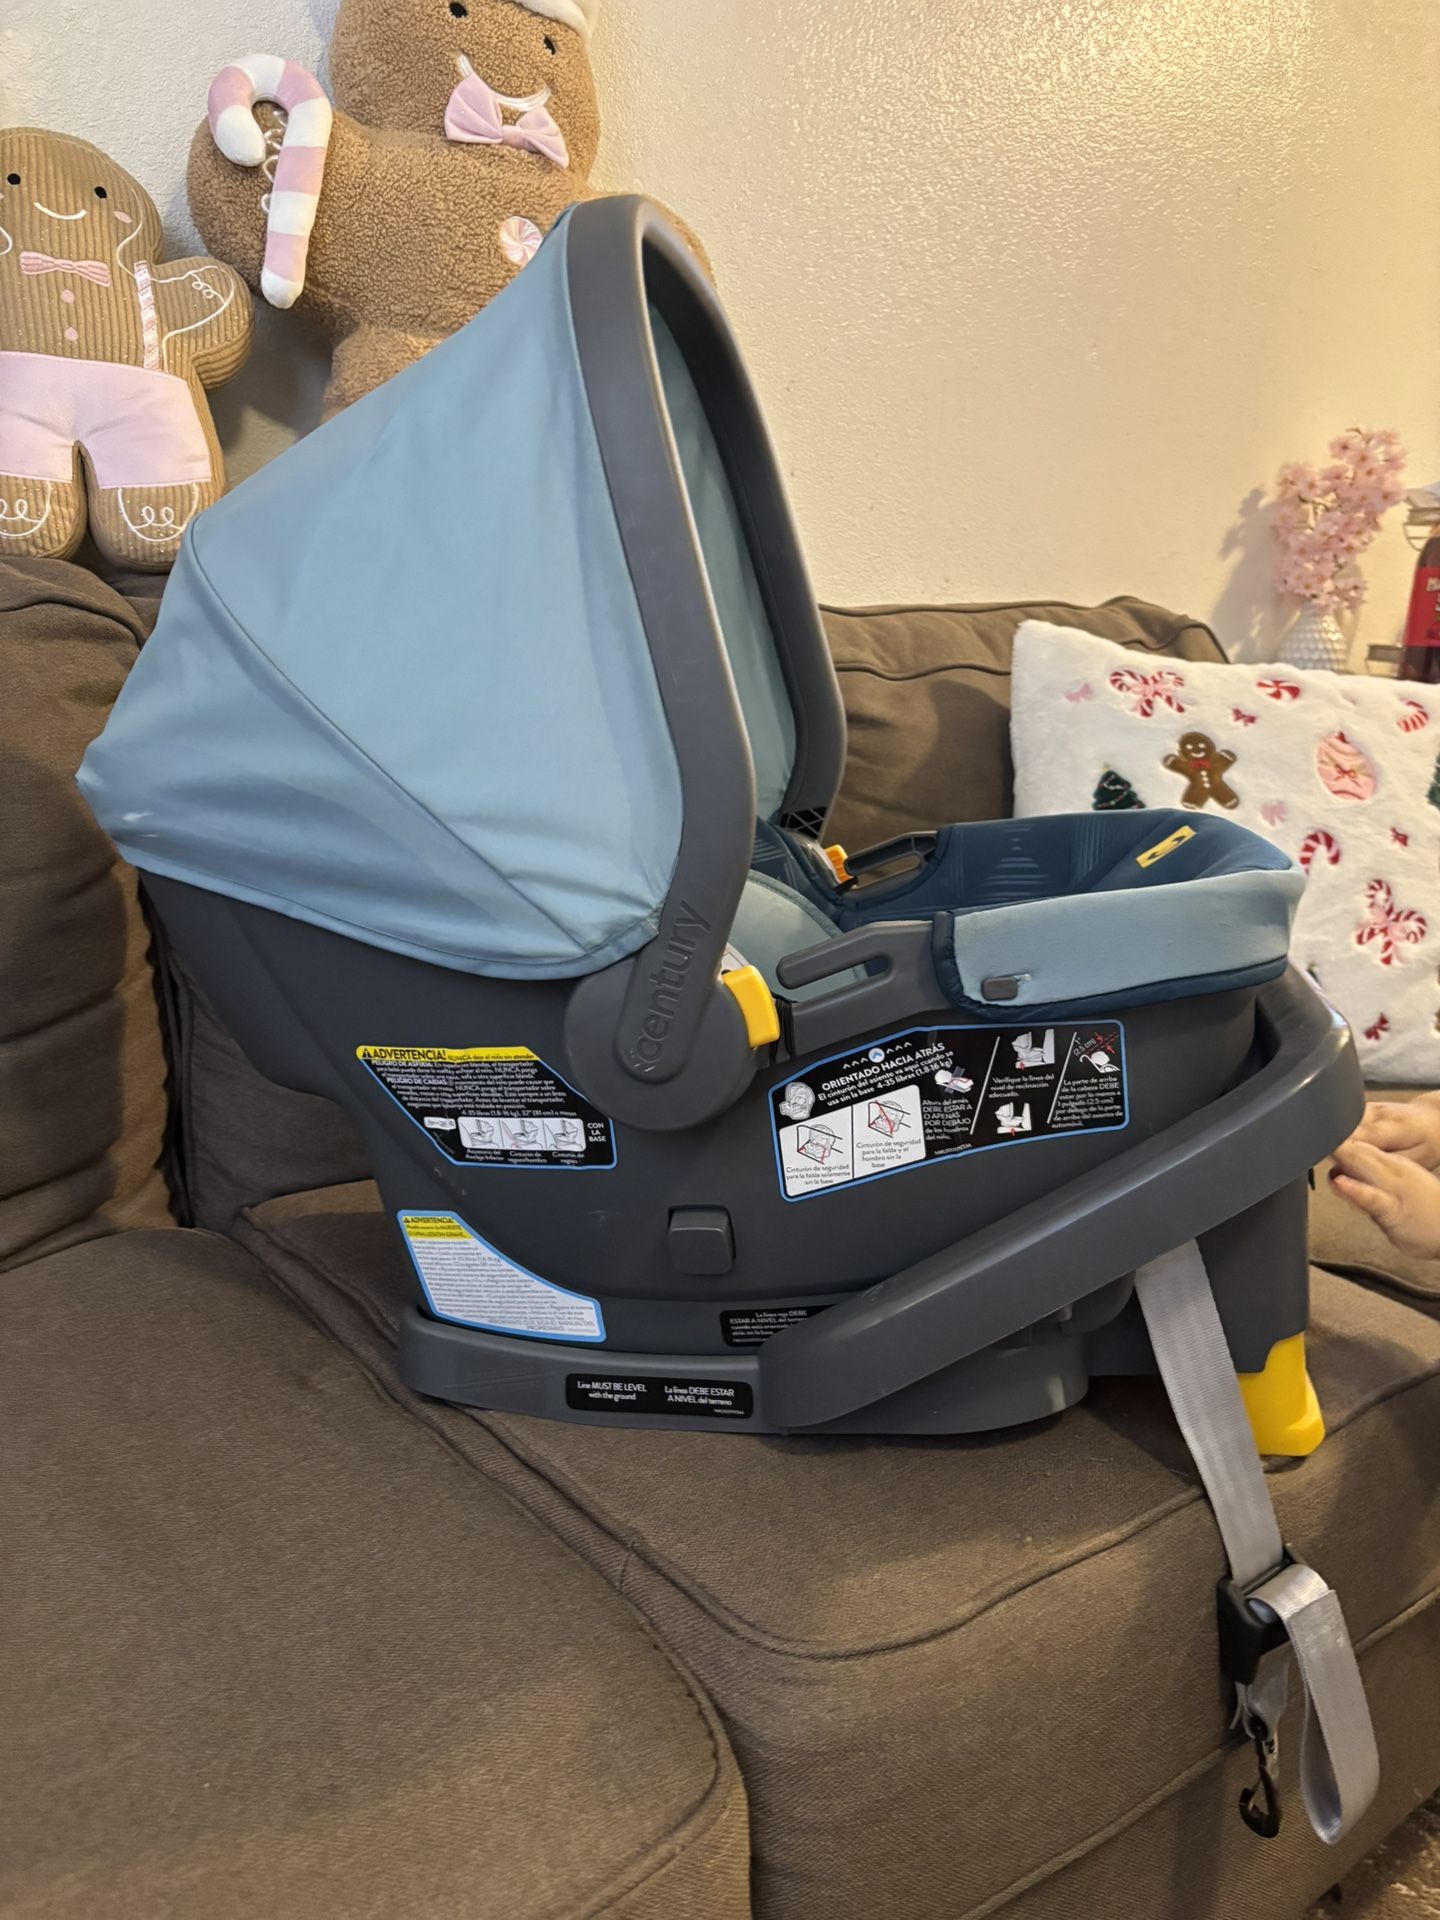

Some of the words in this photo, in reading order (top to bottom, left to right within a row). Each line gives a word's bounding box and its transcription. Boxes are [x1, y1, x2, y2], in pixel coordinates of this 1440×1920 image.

[637, 900, 712, 1063] century
[372, 1048, 447, 1061] ADVERTENCIA!
[821, 1065, 881, 1091] ORIENTADO
[881, 1055, 914, 1071] HACIA
[915, 1043, 945, 1060] ATRÁS
[818, 1093, 827, 1101] El
[827, 1084, 856, 1098] cinturón
[857, 1079, 869, 1088] del
[869, 1072, 894, 1085] asiento
[920, 1056, 944, 1068] cuando
[827, 1099, 839, 1107] usa
[840, 1095, 850, 1103] sin
[858, 1087, 875, 1097] base
[877, 1079, 896, 1090] 4-35
[896, 1073, 916, 1085] libras
[940, 1059, 953, 1070] kg)
[1099, 1082, 1120, 1090] DEBE
[941, 1117, 972, 1127] DEBAJO
[785, 1165, 813, 1173] Cinturón
[821, 1163, 849, 1173] seguridad
[577, 1380, 591, 1389] Line
[591, 1382, 612, 1391] MUST
[612, 1383, 623, 1391] BE
[624, 1383, 648, 1392] LEVEL
[664, 1385, 673, 1393] La
[688, 1386, 710, 1396] DEBE
[710, 1388, 735, 1397] ESTAR
[588, 1391, 602, 1399] with
[602, 1391, 614, 1399] the
[614, 1392, 638, 1402] ground
[667, 1394, 674, 1402] A
[674, 1395, 698, 1404] NIVEL
[698, 1396, 708, 1404] del
[708, 1398, 733, 1406] terreno
